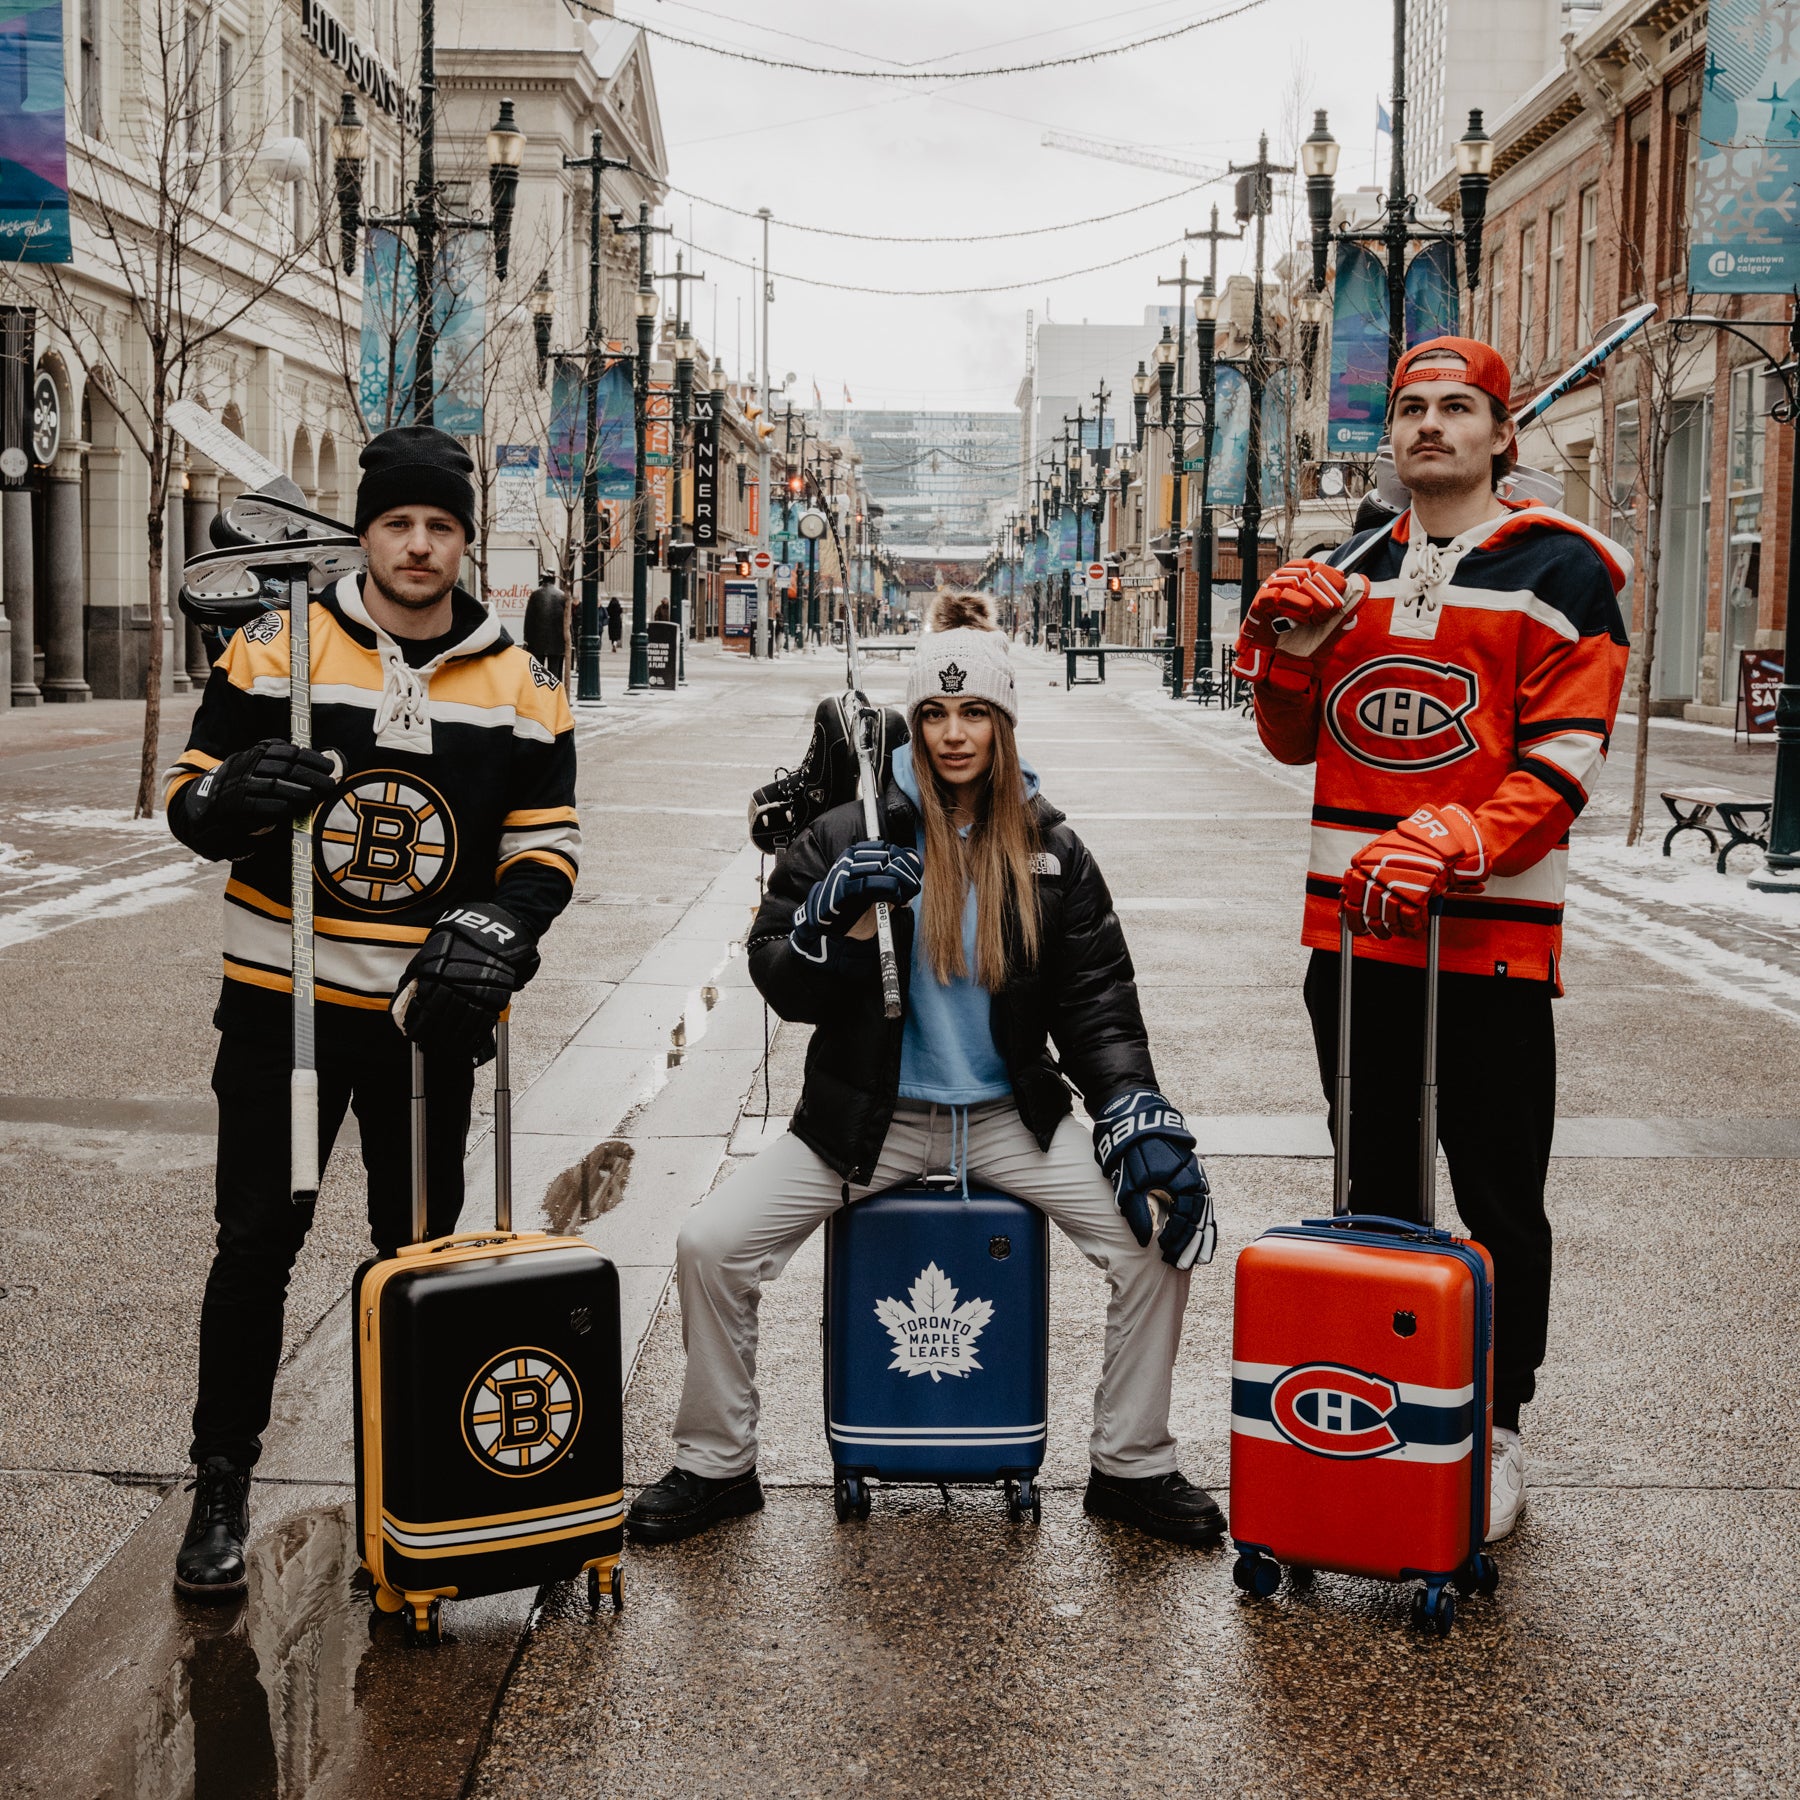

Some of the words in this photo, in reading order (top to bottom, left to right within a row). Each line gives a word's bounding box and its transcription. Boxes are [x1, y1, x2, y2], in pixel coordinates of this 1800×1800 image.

[1737, 254, 1784, 264] downtown
[1737, 264, 1771, 275] calgary
[694, 401, 715, 539] WINNERS
[897, 1316, 972, 1336] TORONTO
[909, 1333, 960, 1345] MAPLE
[909, 1346, 960, 1358] LEAFS
